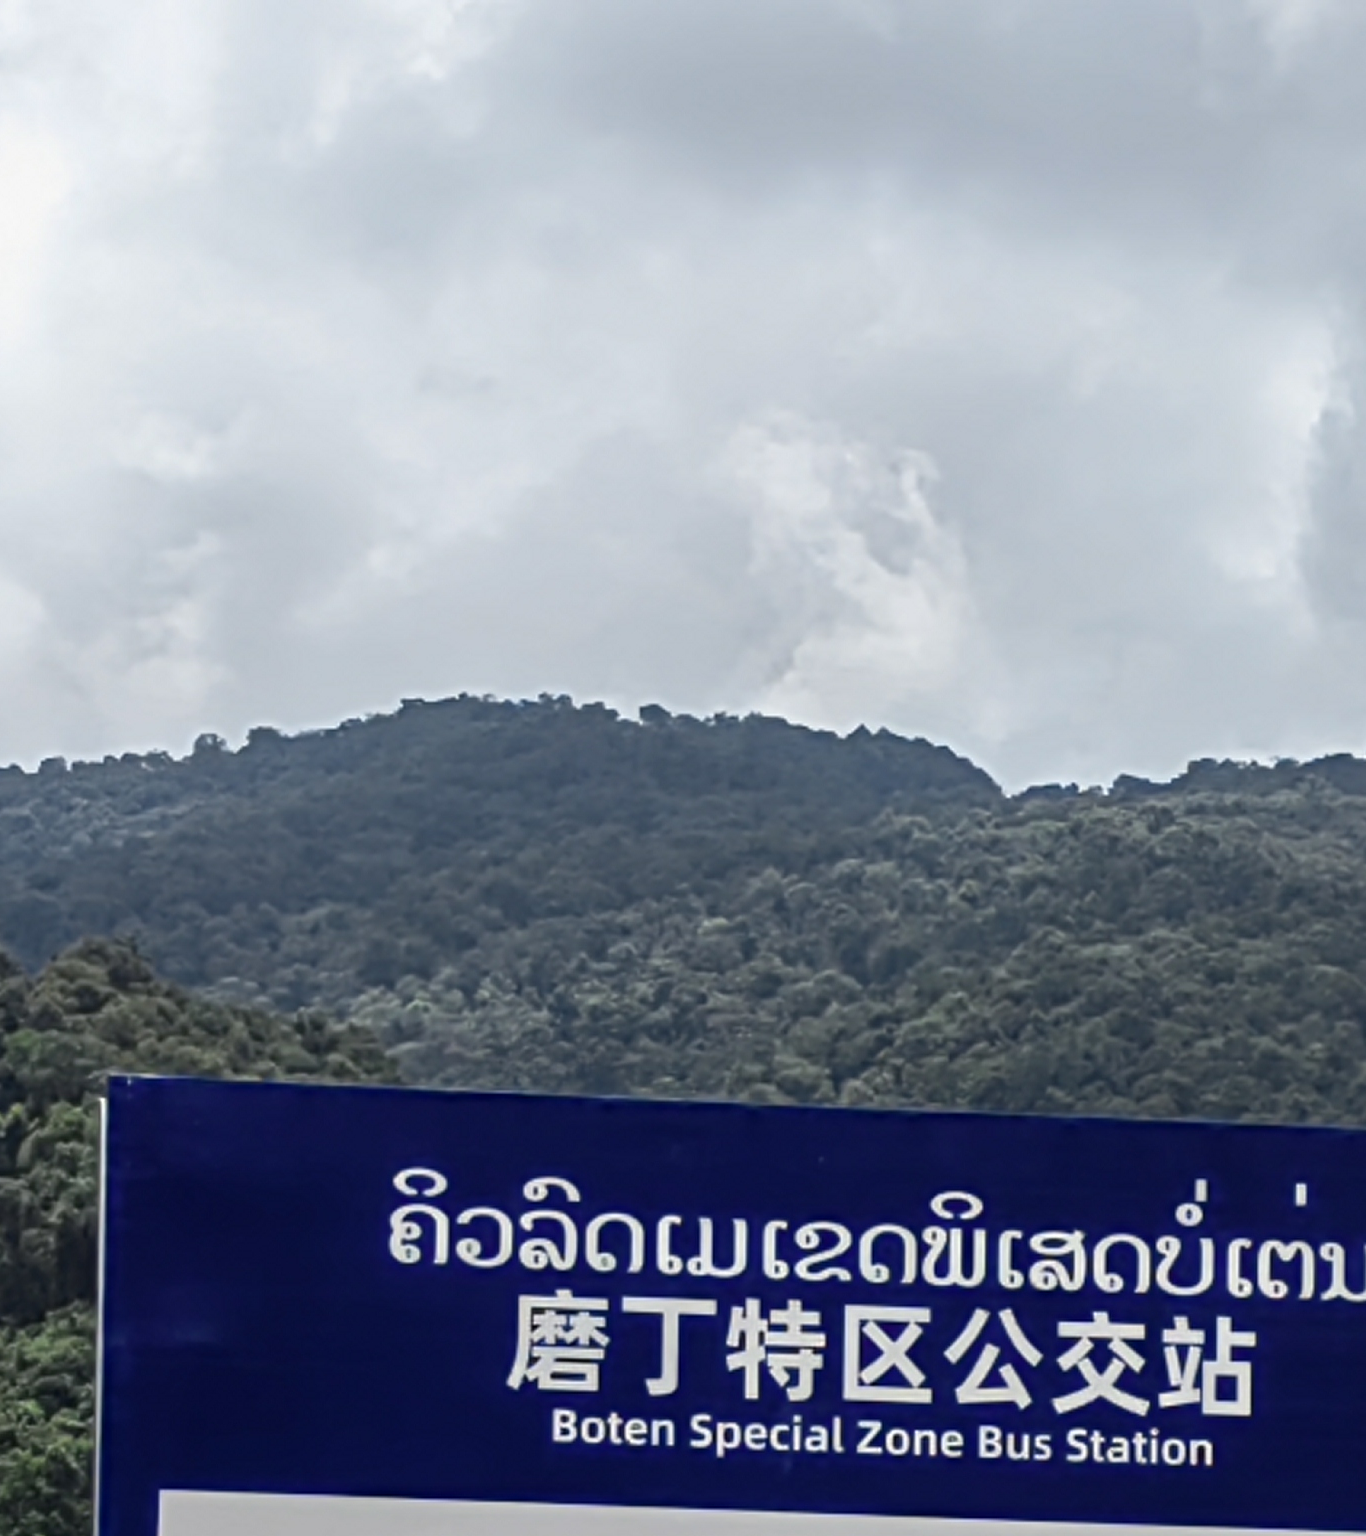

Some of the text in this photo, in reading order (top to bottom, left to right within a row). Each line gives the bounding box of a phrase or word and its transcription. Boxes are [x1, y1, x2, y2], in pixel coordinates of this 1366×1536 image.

[505, 1288, 1258, 1418] 磨丁特区公交站
[551, 1407, 1214, 1467] Boten Special Zone Bus Station
